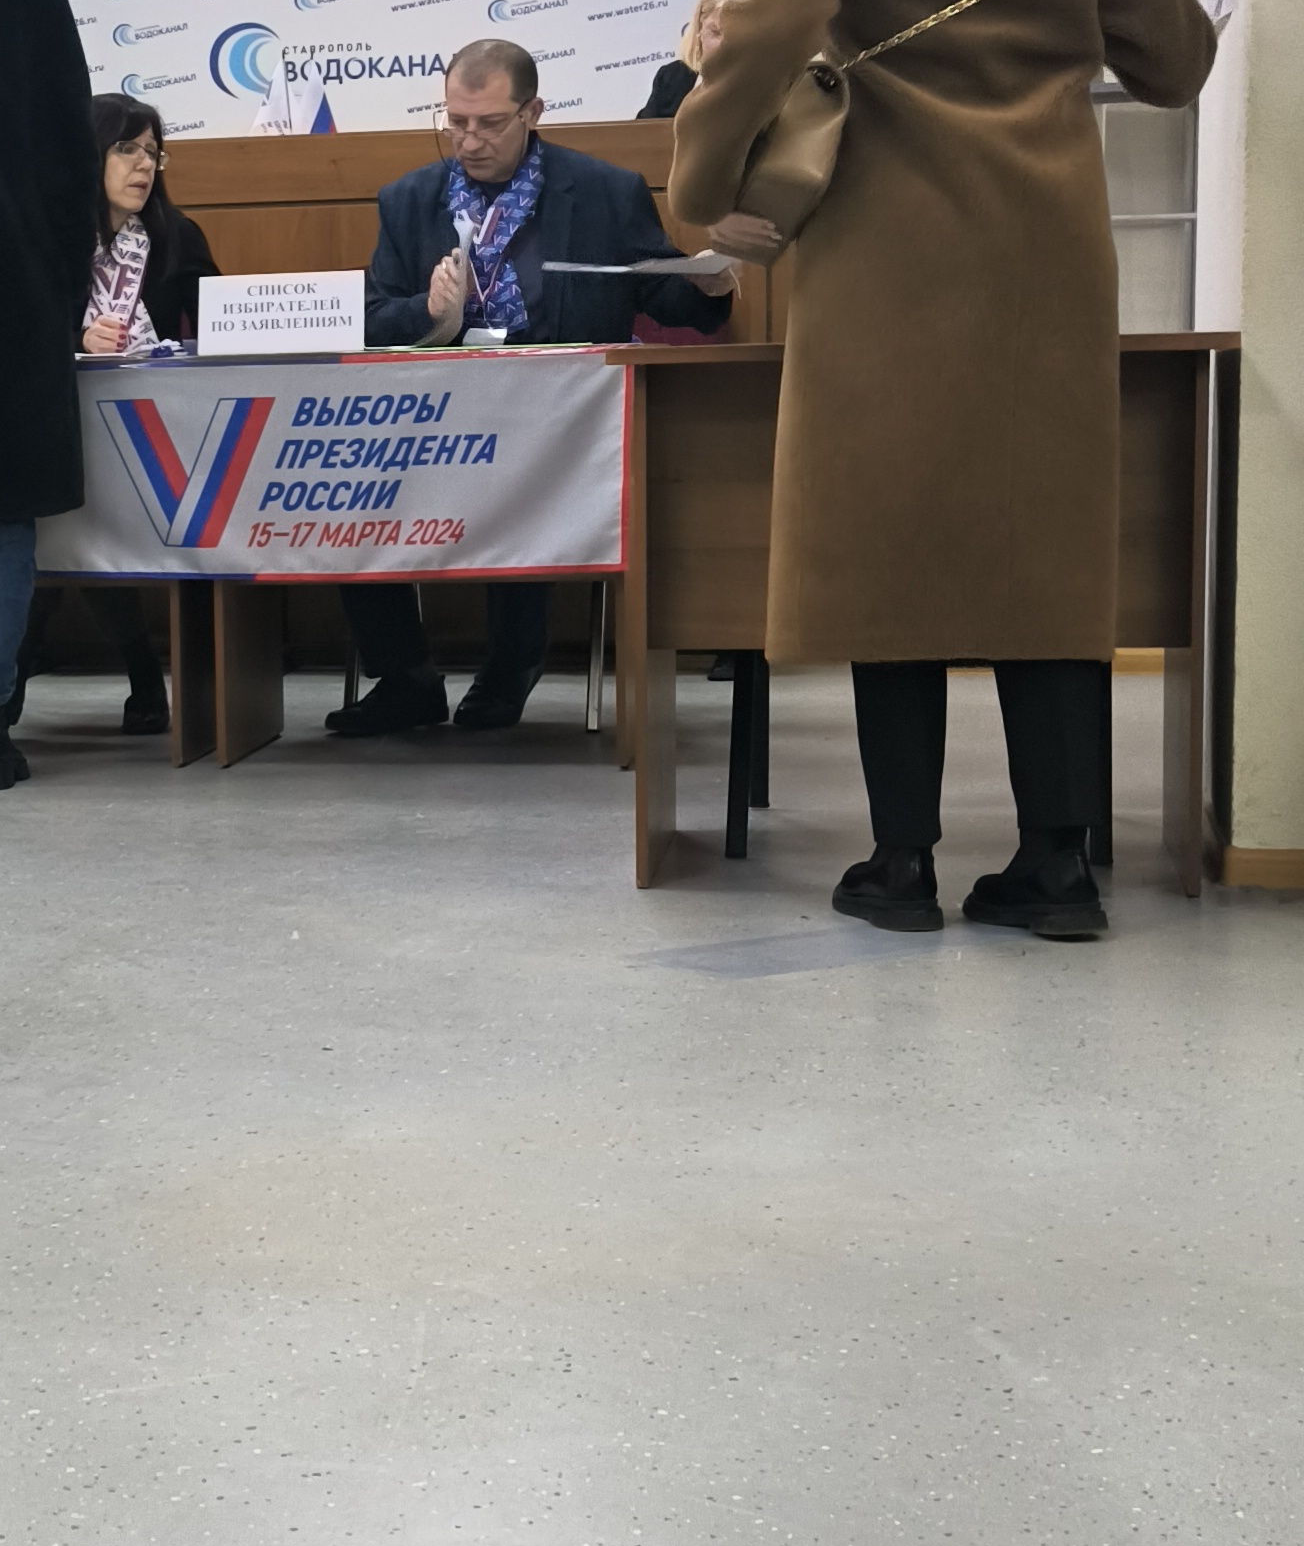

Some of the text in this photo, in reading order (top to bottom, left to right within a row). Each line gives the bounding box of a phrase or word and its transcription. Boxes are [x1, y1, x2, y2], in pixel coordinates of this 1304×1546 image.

[587, 0, 668, 21] www.water26.ru
[134, 23, 188, 40] ВОДОКАНАЛ
[283, 43, 372, 55] СТАВРОПОЛЬ
[534, 48, 575, 63] ДОКАНАЛ
[284, 53, 453, 85] ВОДОКАНА
[595, 51, 675, 72] www.water26.ru
[143, 73, 196, 90] ВОДОКАНАЛ
[544, 98, 582, 113] ОКАНАЛ
[162, 121, 205, 137] ДОКАНАЛ
[247, 283, 317, 297] СПИСОК
[223, 297, 341, 315] ИЗБИРАТЕЛЕЙ
[211, 315, 352, 332] ПО ЗАЯВЛЕНИЯМ
[291, 392, 451, 427] ВЫБОРЫ
[274, 434, 498, 472] ПРЕЗИДЕНТА
[258, 479, 402, 511] РОССИИ
[317, 520, 399, 548] МАРТА
[405, 519, 465, 546] 2024
